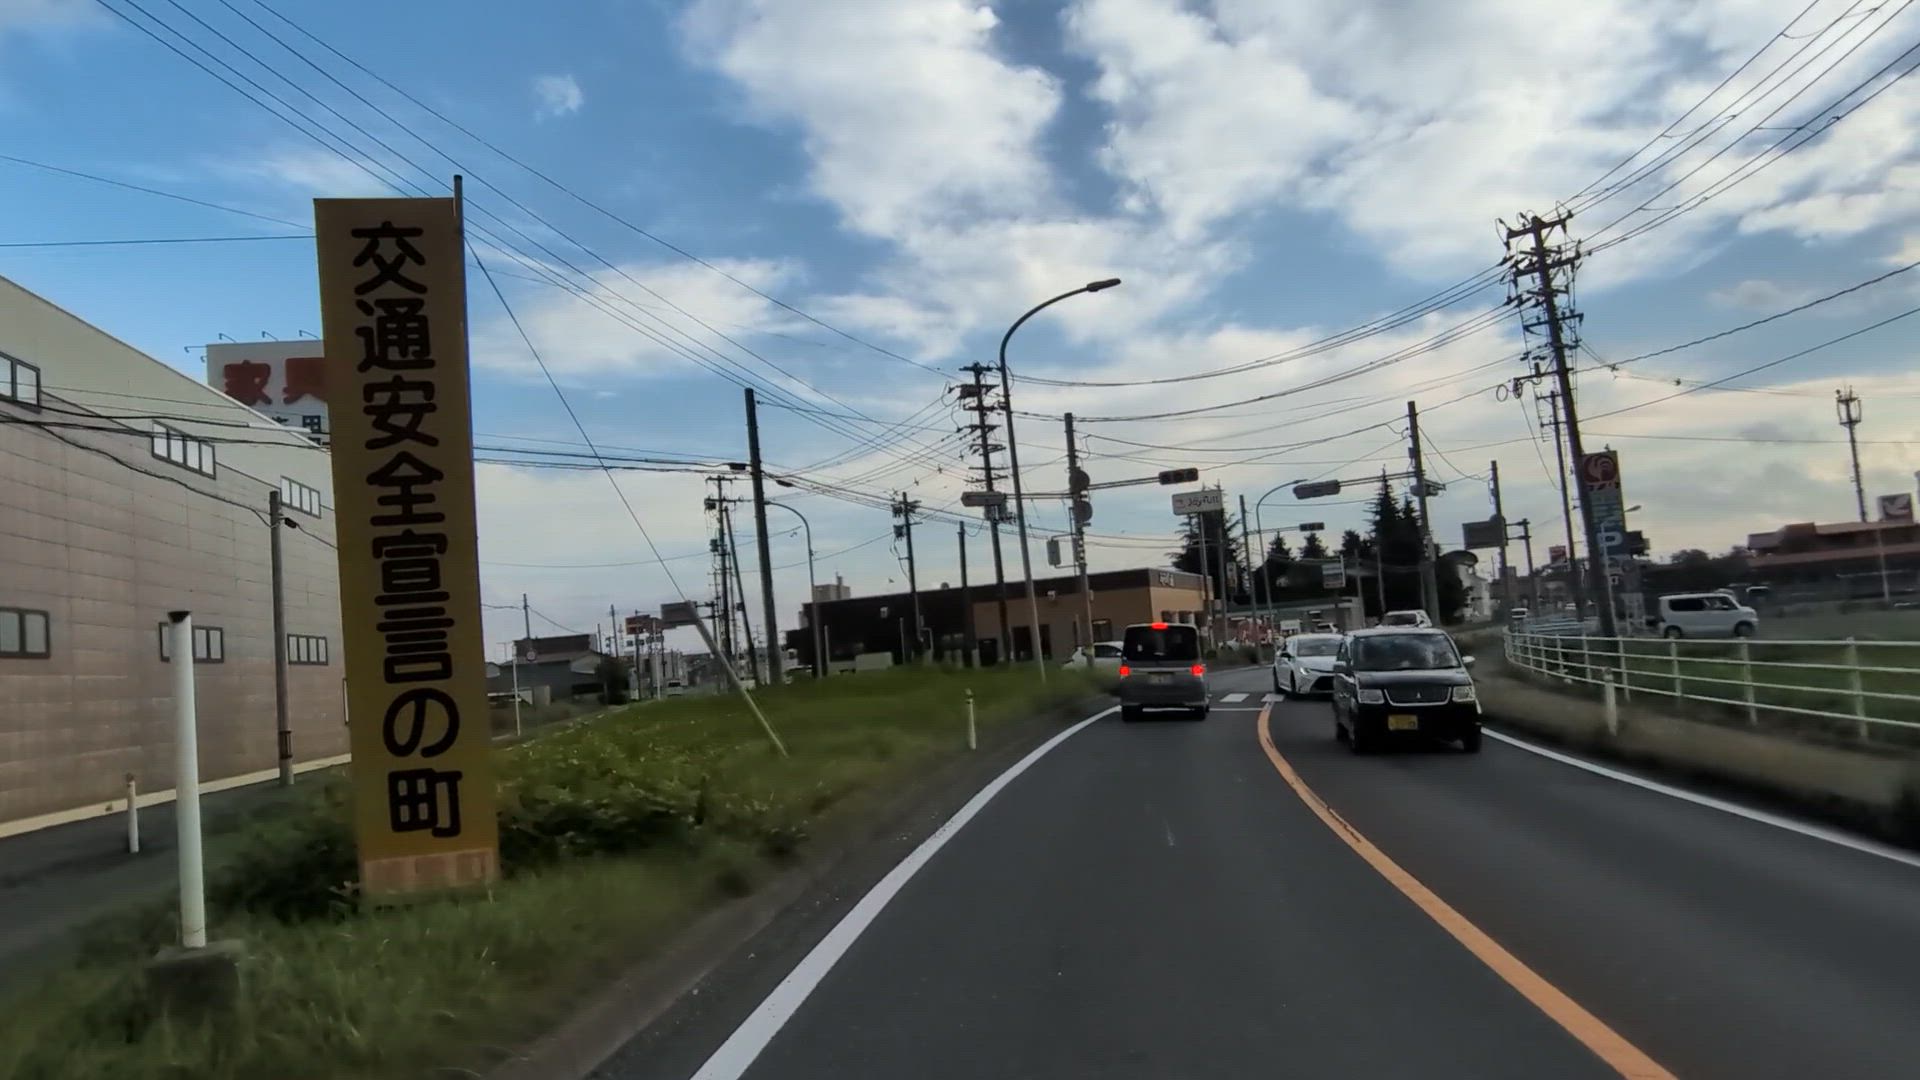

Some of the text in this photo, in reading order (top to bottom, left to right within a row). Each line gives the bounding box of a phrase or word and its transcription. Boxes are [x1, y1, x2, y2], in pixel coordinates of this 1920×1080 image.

[351, 220, 462, 838] 交通安全宣言の町
